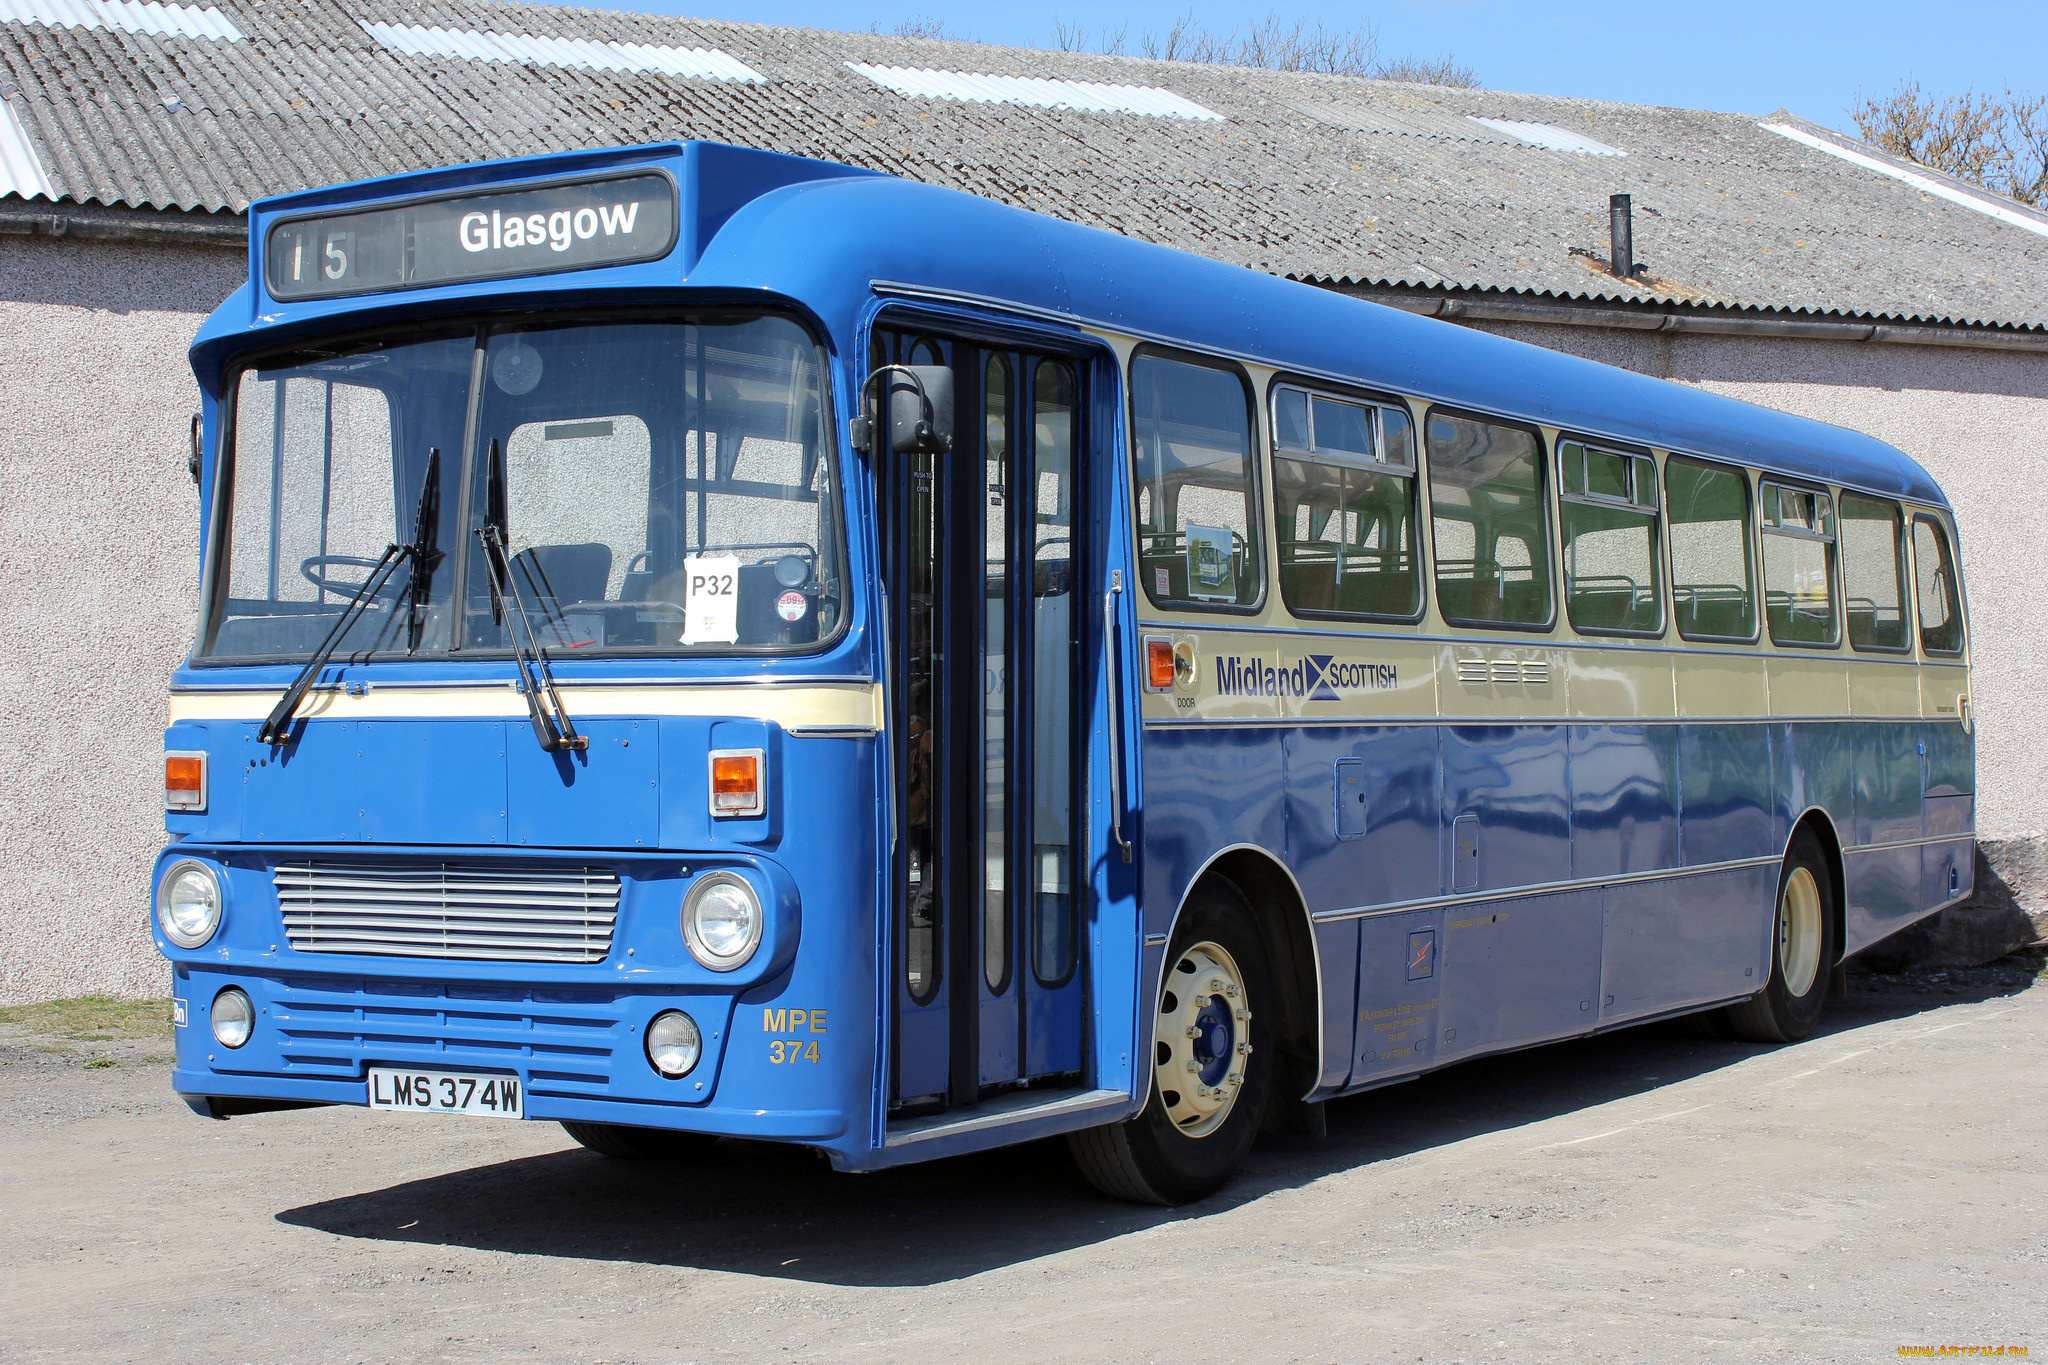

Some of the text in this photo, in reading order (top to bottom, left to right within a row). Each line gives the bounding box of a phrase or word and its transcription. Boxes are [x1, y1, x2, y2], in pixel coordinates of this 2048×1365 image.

[459, 202, 639, 252] Glasgow
[692, 574, 733, 596] P32
[1216, 656, 1398, 697] Midland SCOTTISH
[1177, 697, 1196, 708] DOOR
[763, 1008, 828, 1033] MPE
[769, 1040, 820, 1064] 374
[373, 1074, 518, 1112] LMS 374W
